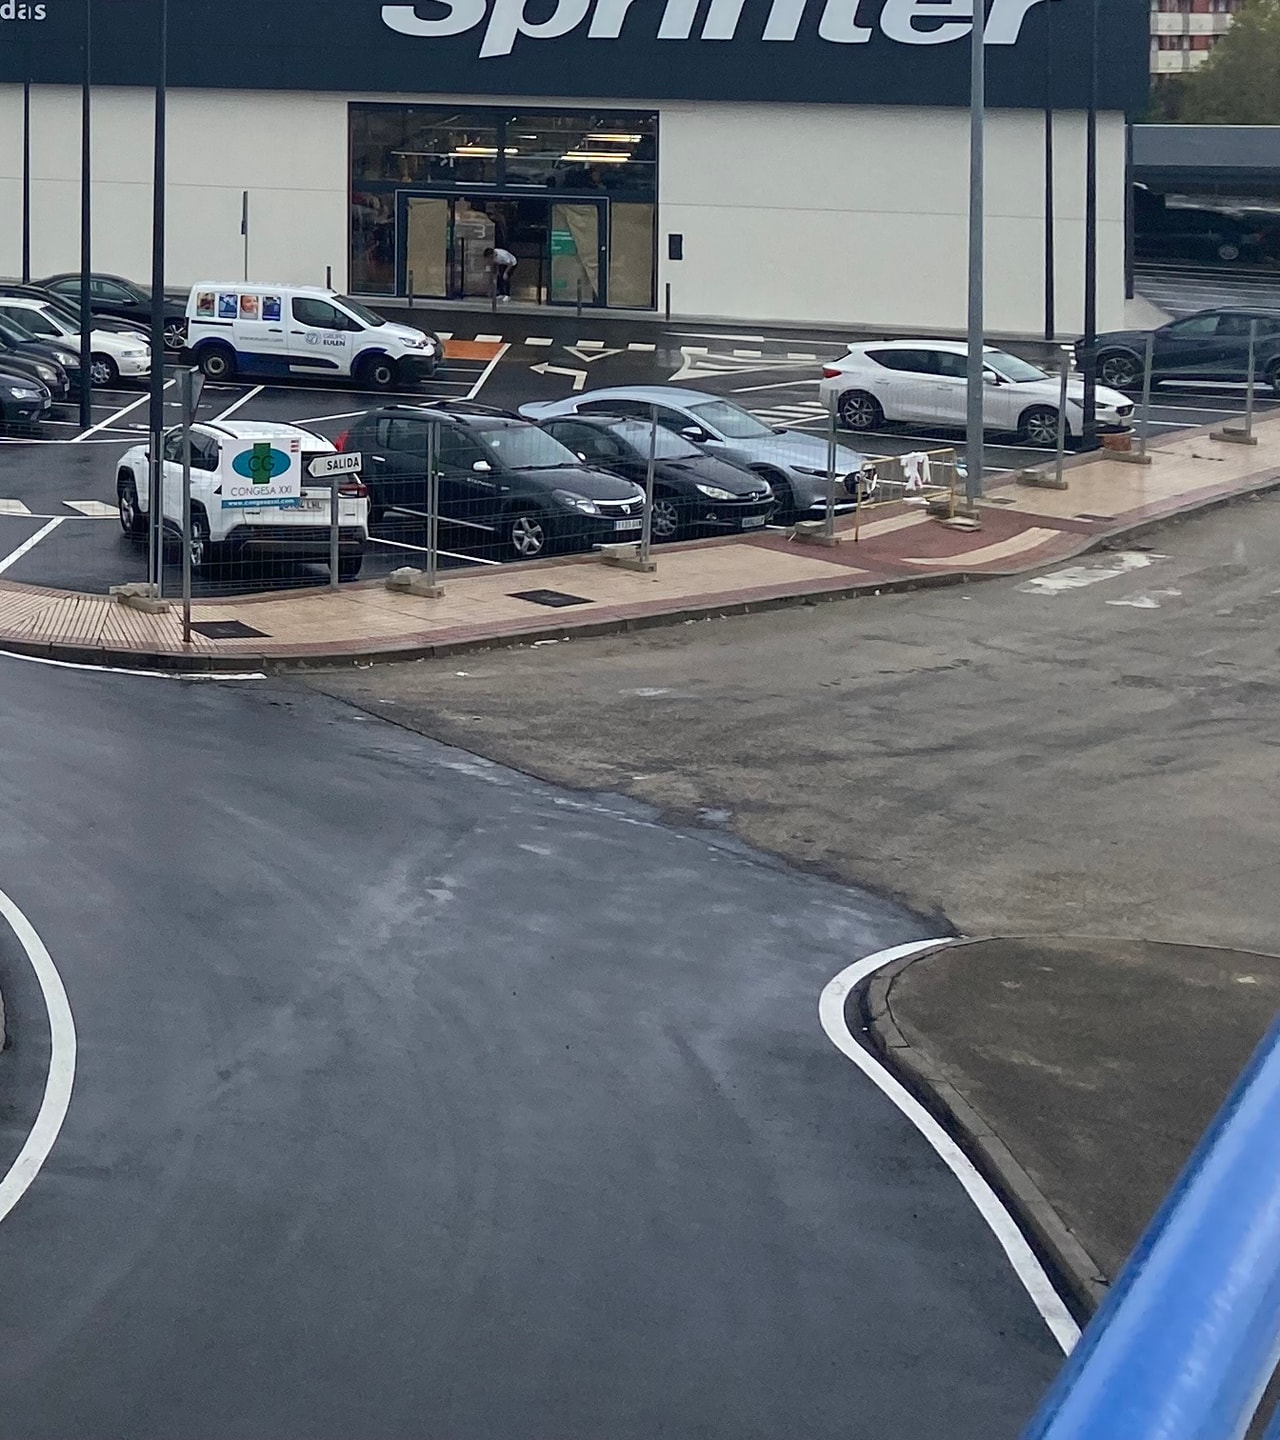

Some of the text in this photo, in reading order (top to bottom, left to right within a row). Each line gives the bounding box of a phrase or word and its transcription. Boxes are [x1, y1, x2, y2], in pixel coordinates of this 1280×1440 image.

[323, 339, 346, 347] EULEN
[248, 455, 275, 472] CG
[326, 456, 360, 471] SALIDA
[230, 485, 292, 497] CONGESA XXI
